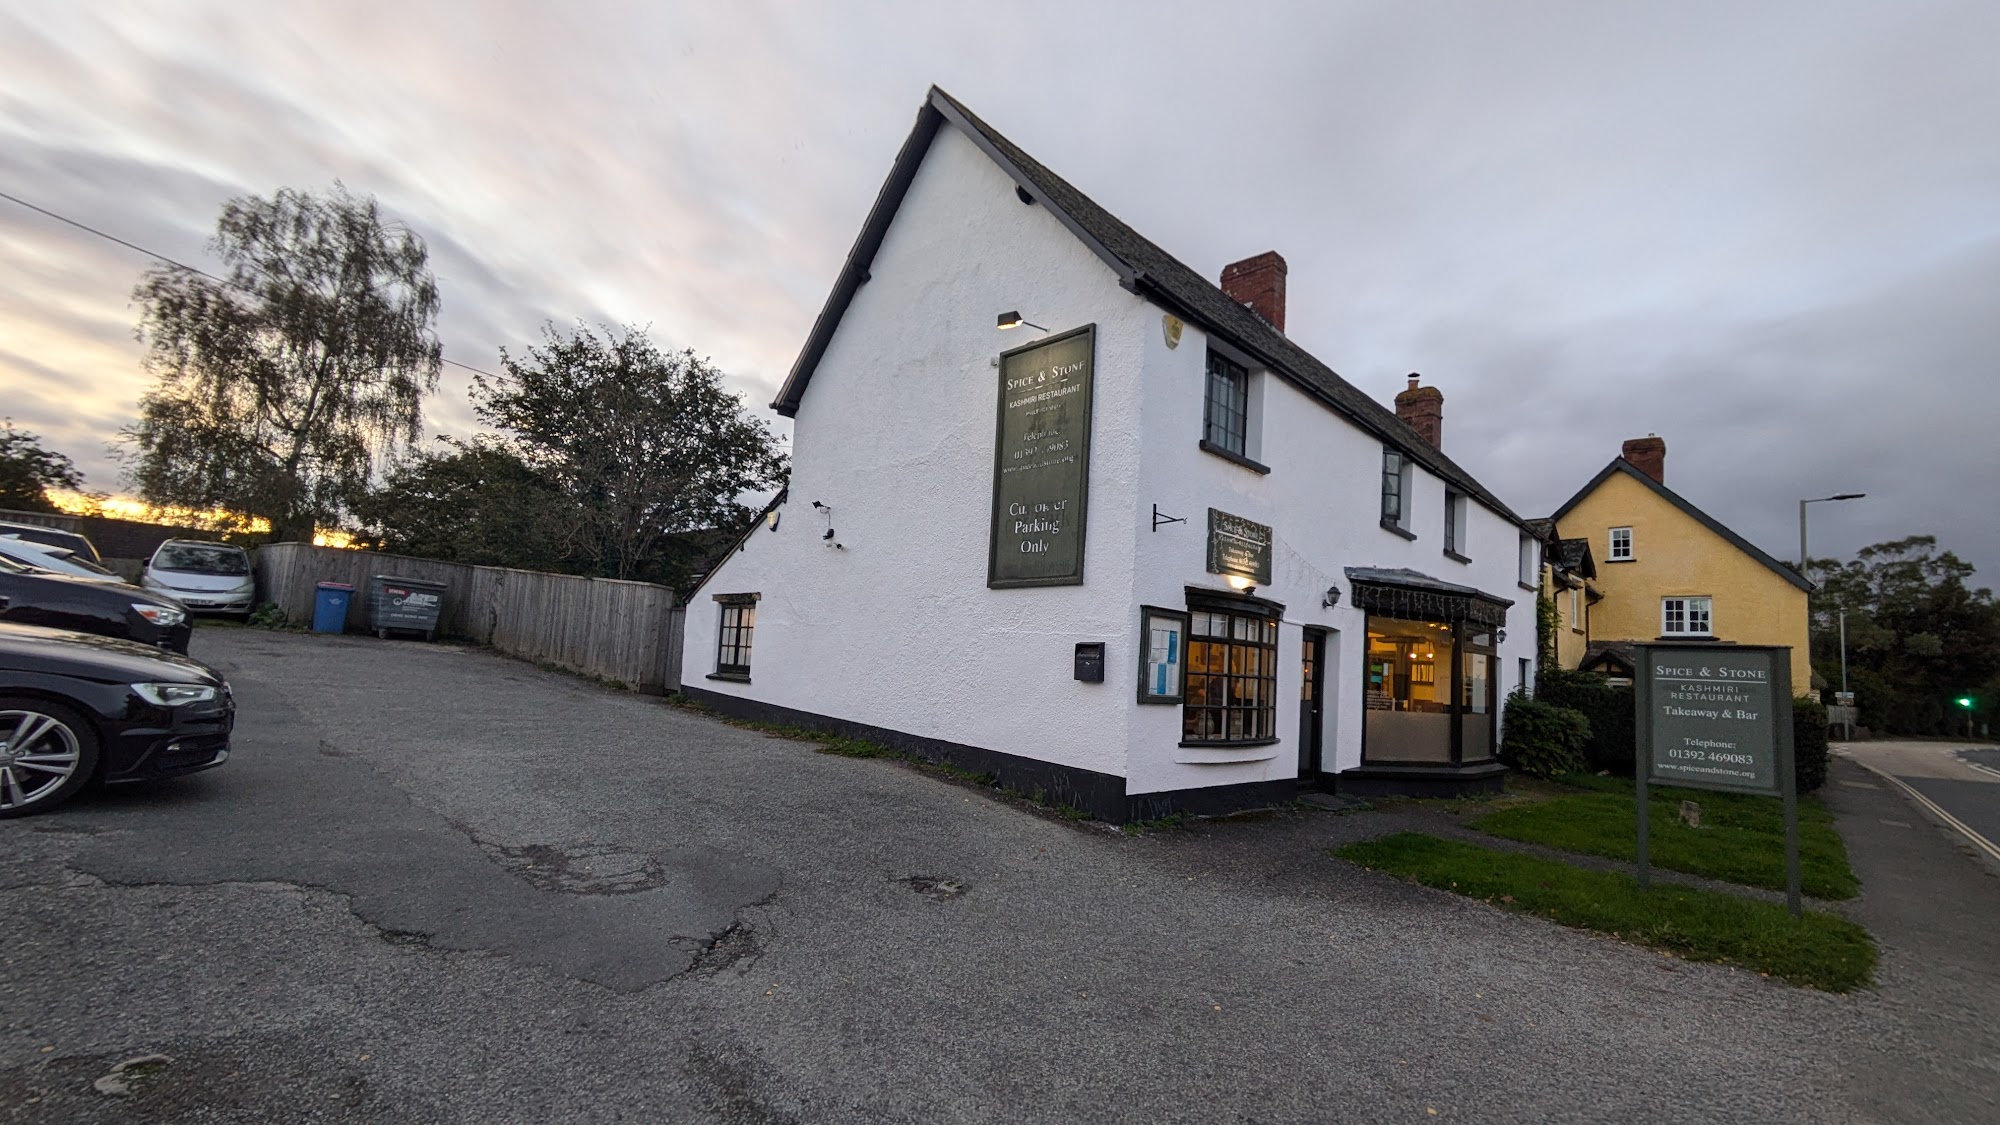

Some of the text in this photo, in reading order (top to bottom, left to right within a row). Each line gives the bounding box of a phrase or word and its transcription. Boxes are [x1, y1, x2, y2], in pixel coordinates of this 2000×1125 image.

[1007, 376, 1034, 391] SPICE
[1038, 370, 1046, 383] &
[1009, 384, 1081, 409] KASHMIRI RESTAURANT
[1009, 499, 1068, 516] Cuoer
[1014, 518, 1060, 534] Parking
[1020, 539, 1049, 556] Only
[1656, 665, 1766, 679] SPICE & STONE
[1680, 684, 1739, 693] KASHMIRI
[1670, 692, 1750, 702] RESTAURANT
[1662, 705, 1758, 720] Takeaway & Bar
[1683, 737, 1736, 749] Telephone:
[1669, 749, 1753, 765] 01392 469083
[1657, 763, 1756, 779] www.spiceandstone.org
